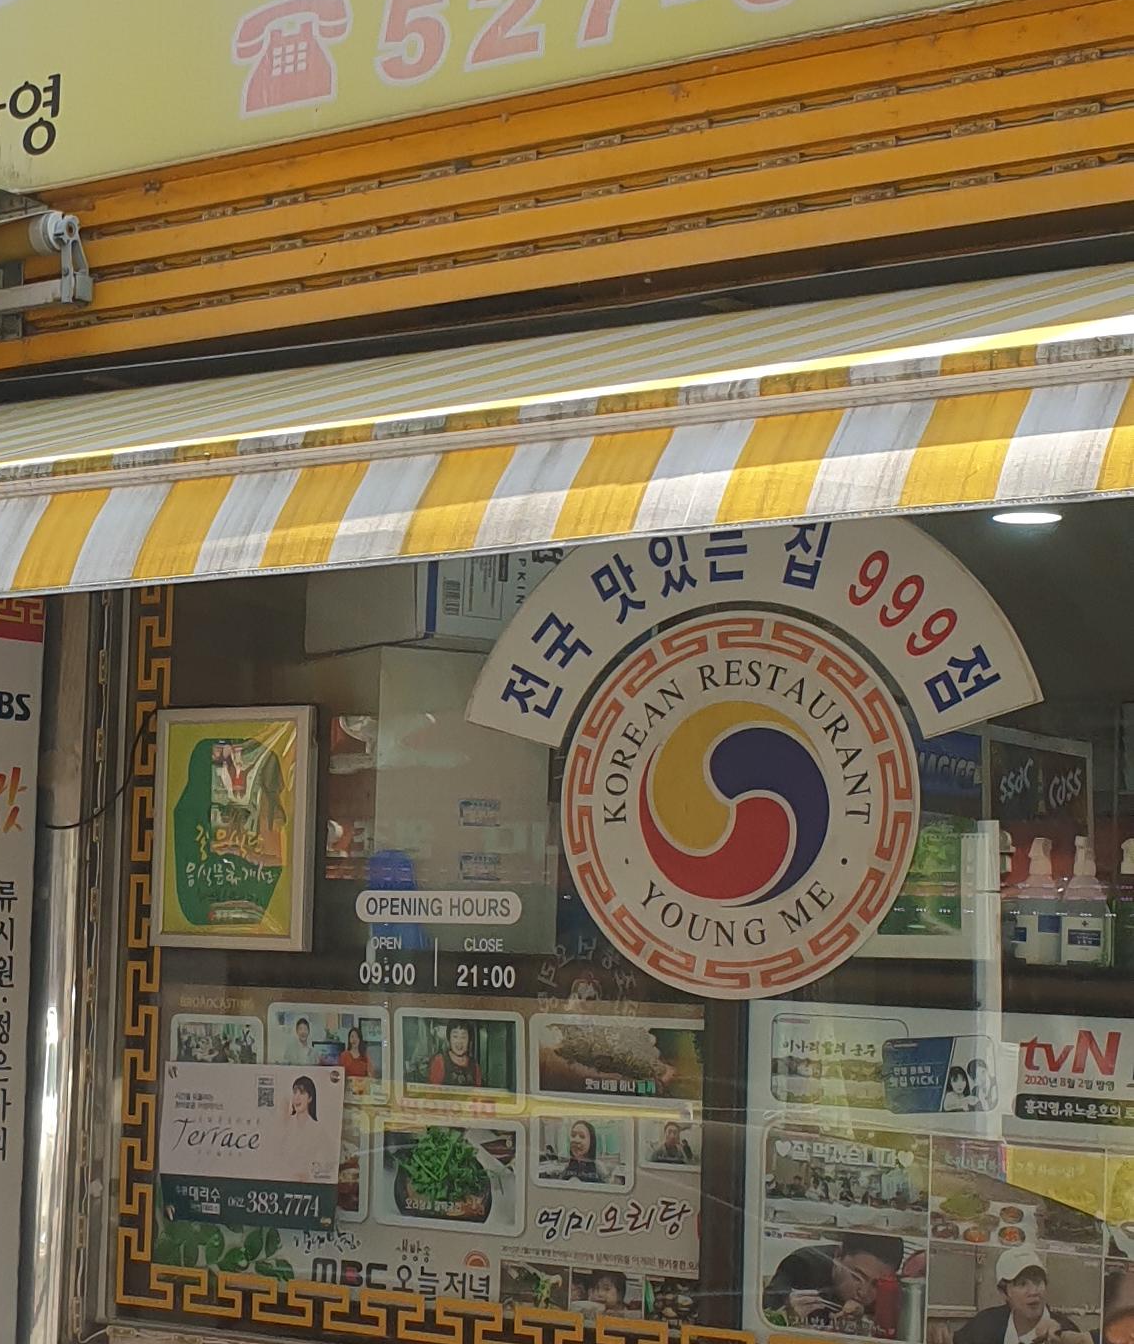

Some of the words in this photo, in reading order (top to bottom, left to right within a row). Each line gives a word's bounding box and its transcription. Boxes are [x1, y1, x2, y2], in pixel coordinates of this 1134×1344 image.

[500, 612, 593, 719] 전국
[848, 549, 1001, 714] 999점
[603, 678, 685, 825] KOREAN
[697, 659, 872, 825] RESTAURANT
[366, 897, 443, 916] OPENING
[449, 898, 511, 917] HOURS
[639, 879, 766, 947] YOUNG
[778, 881, 835, 935] ME
[371, 936, 402, 950] OPEN
[464, 937, 504, 952] CLOSE
[359, 962, 416, 985] 09:00
[456, 964, 516, 988] 21:00
[1020, 1030, 1122, 1075] tvN
[172, 1118, 261, 1151] Terrace
[246, 1190, 320, 1218] 383.7774
[311, 1258, 388, 1289] MBC
[396, 1264, 492, 1302] 오늘저녁
